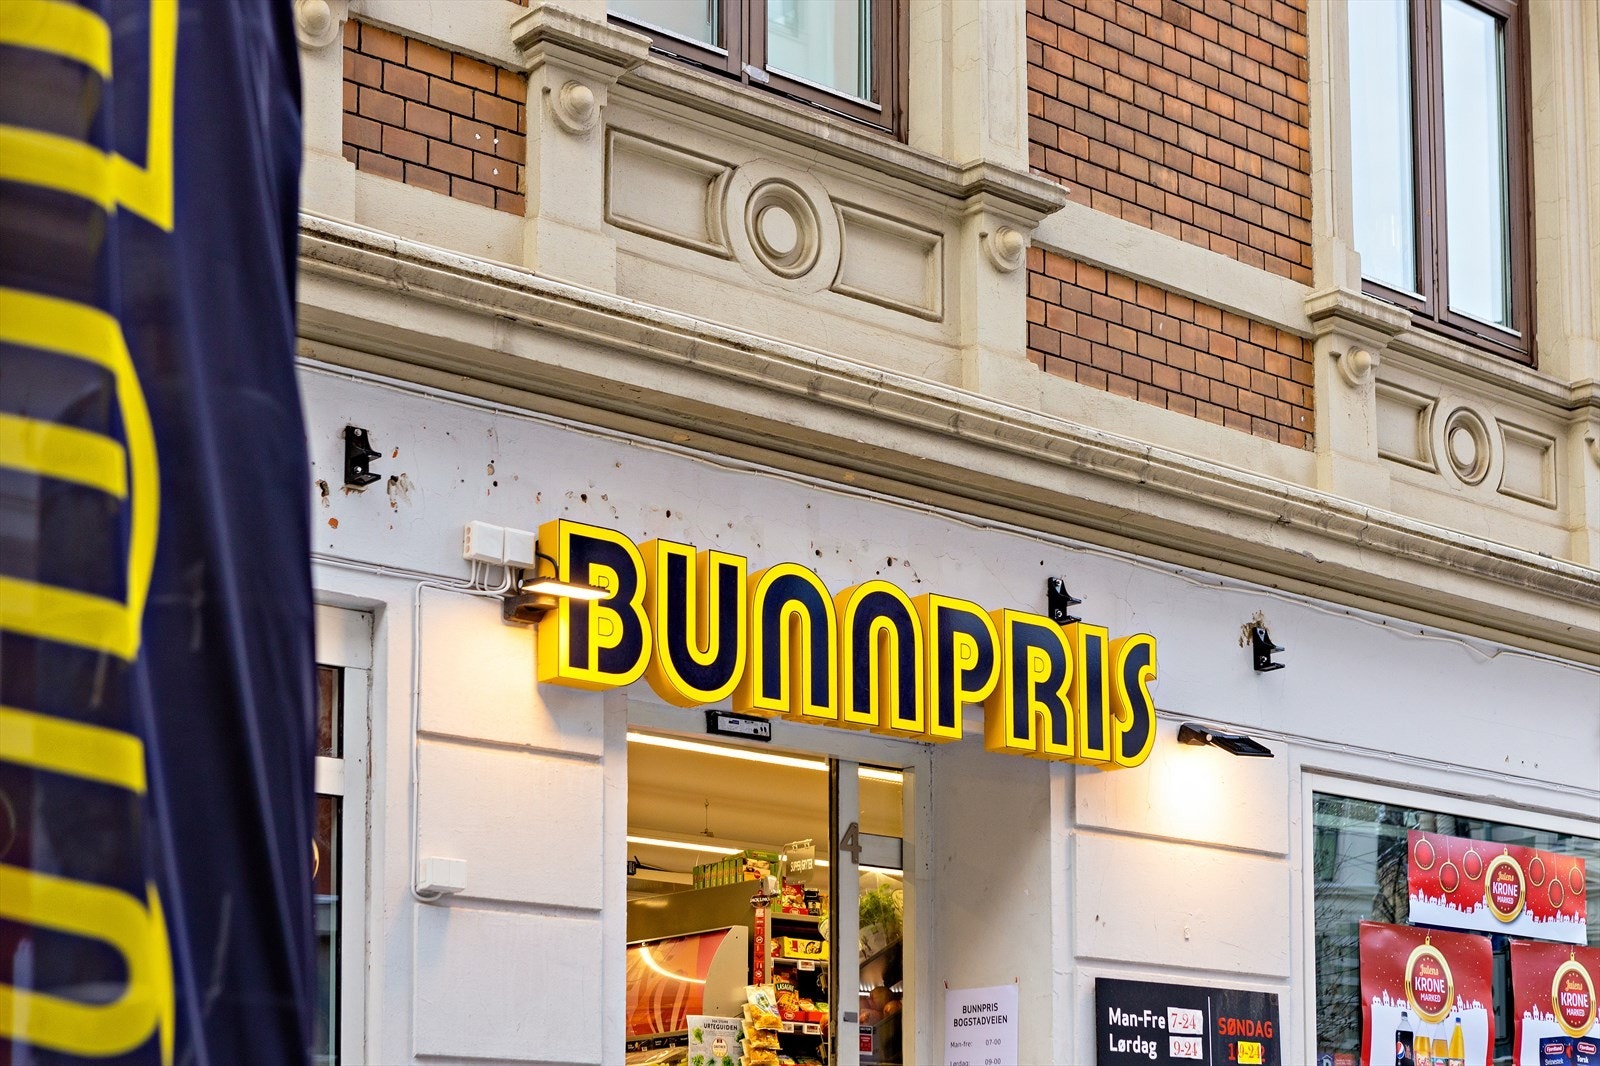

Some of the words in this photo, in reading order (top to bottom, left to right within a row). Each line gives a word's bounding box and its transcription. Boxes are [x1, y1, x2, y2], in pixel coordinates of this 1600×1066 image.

[552, 518, 1158, 769] BUNNPRIS
[840, 822, 862, 864] 4
[1497, 871, 1514, 881] Julens
[1492, 882, 1518, 897] KRONE
[1497, 896, 1514, 905] MARKED
[1420, 964, 1439, 976] Julens
[1415, 977, 1445, 994] KRONE
[1565, 980, 1583, 991] Julens
[1420, 993, 1441, 1003] MARKED
[1561, 992, 1589, 1008] KRONE
[962, 1003, 999, 1014] BUNNPRIS
[1566, 1008, 1586, 1017] MARKED
[953, 1015, 1008, 1027] BOGSTADVEIEN
[1108, 1006, 1166, 1029] Man-Fre
[1171, 1012, 1197, 1030] 7-24
[703, 1023, 738, 1031] URTEGUIDEN
[1217, 1017, 1273, 1038] SØNDAG
[1109, 1033, 1157, 1060] Lørdag
[1173, 1041, 1198, 1056] 9-24
